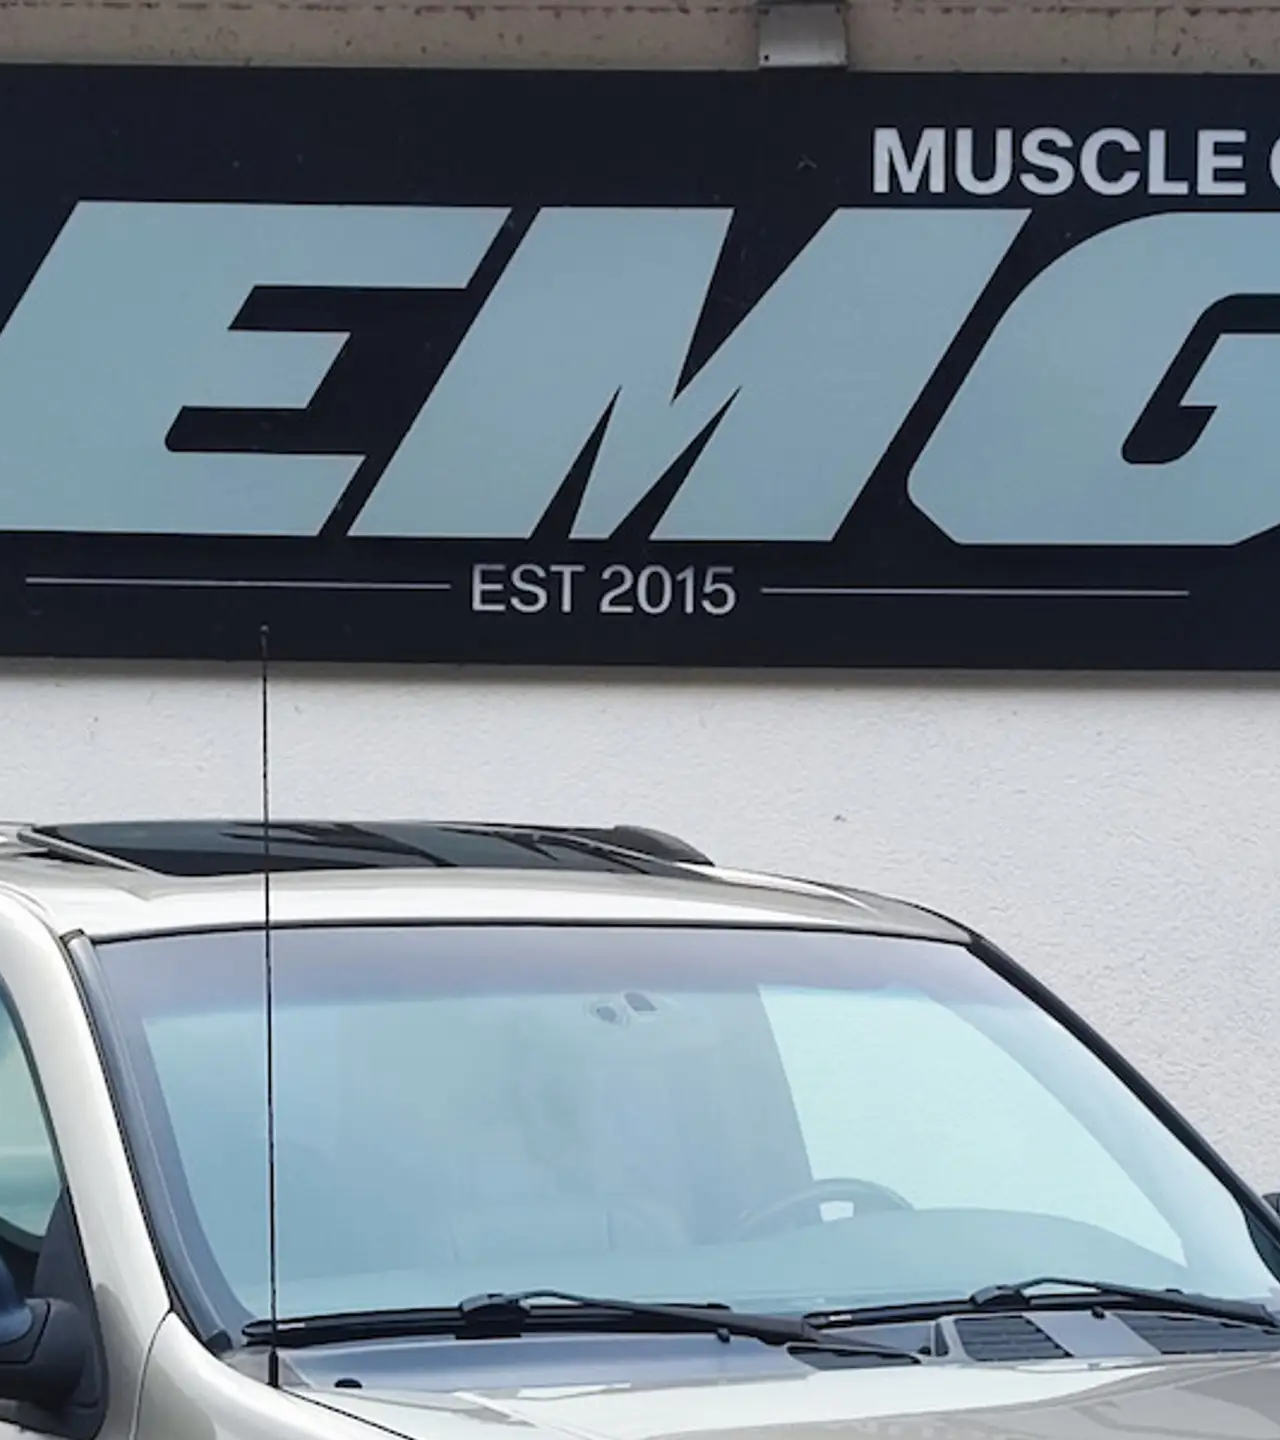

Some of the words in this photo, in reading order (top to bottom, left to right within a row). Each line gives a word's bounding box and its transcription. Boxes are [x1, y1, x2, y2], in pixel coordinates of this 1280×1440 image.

[872, 127, 1247, 196] MUSCLE
[471, 563, 586, 614] EST
[599, 564, 738, 616] 2015
